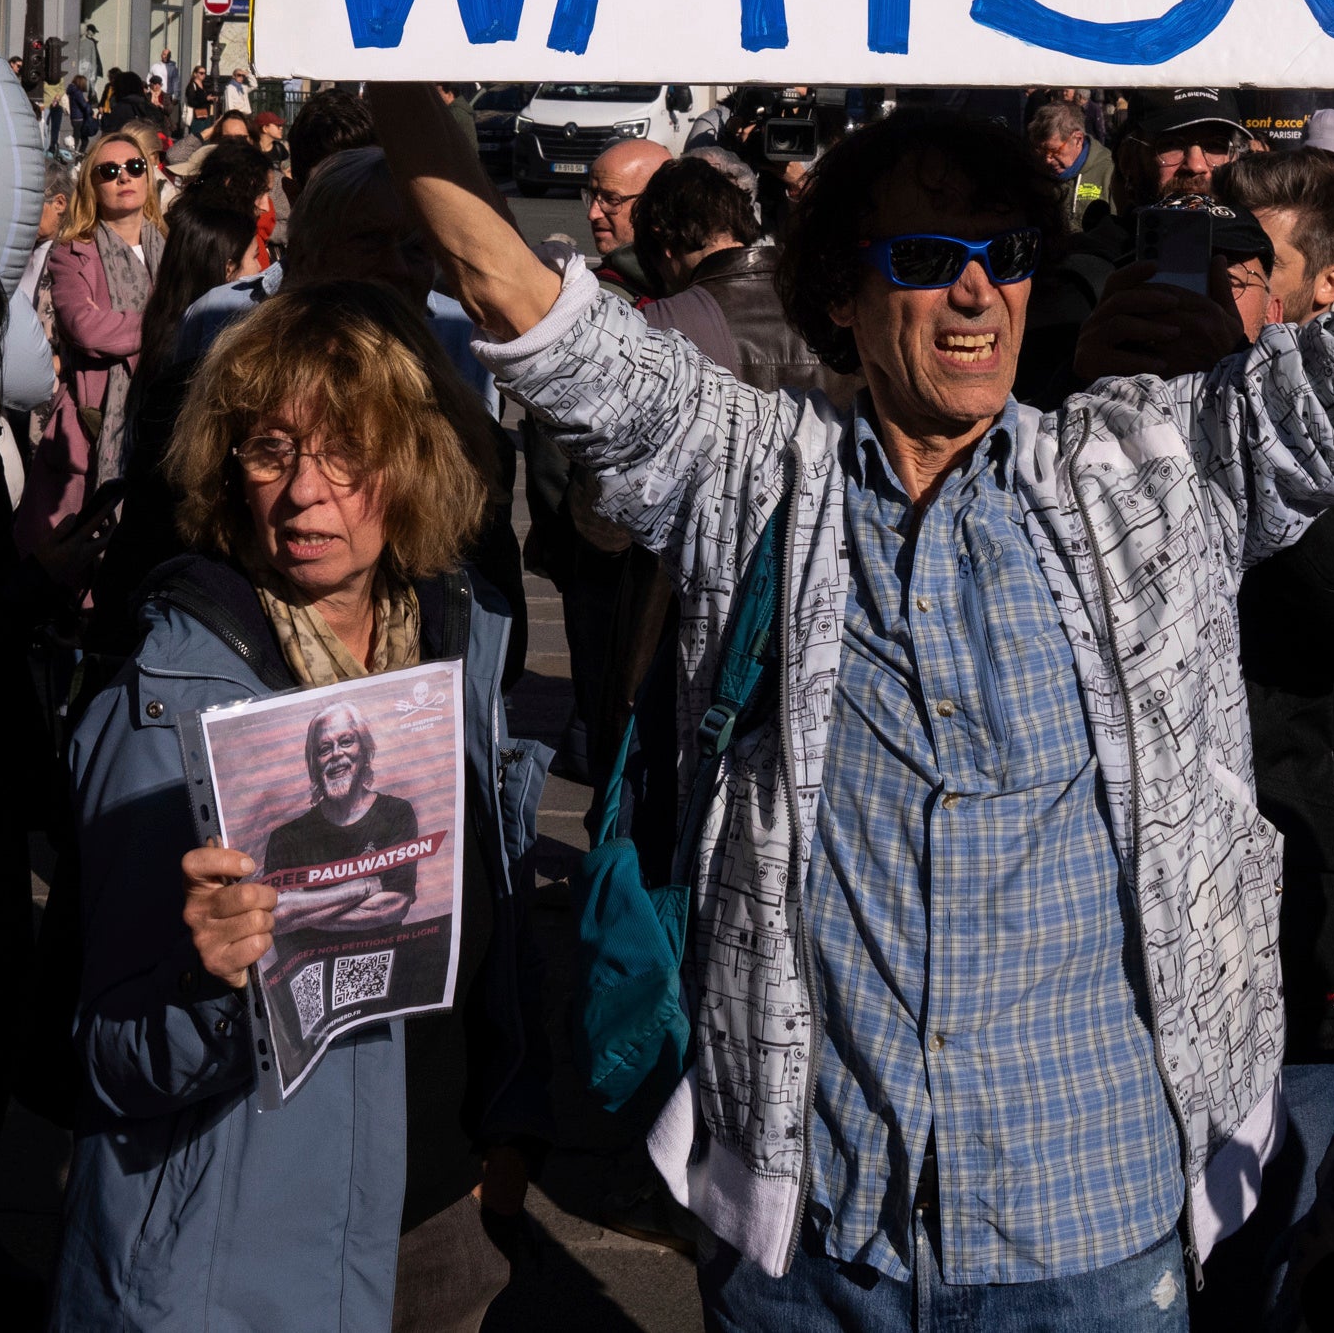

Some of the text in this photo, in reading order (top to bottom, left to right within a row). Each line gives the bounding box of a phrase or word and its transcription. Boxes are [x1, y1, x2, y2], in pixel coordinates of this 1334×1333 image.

[1245, 116, 1272, 128] sont
[318, 944, 340, 955] NOS
[396, 932, 411, 942] EN
[412, 925, 441, 939] LIGNE
